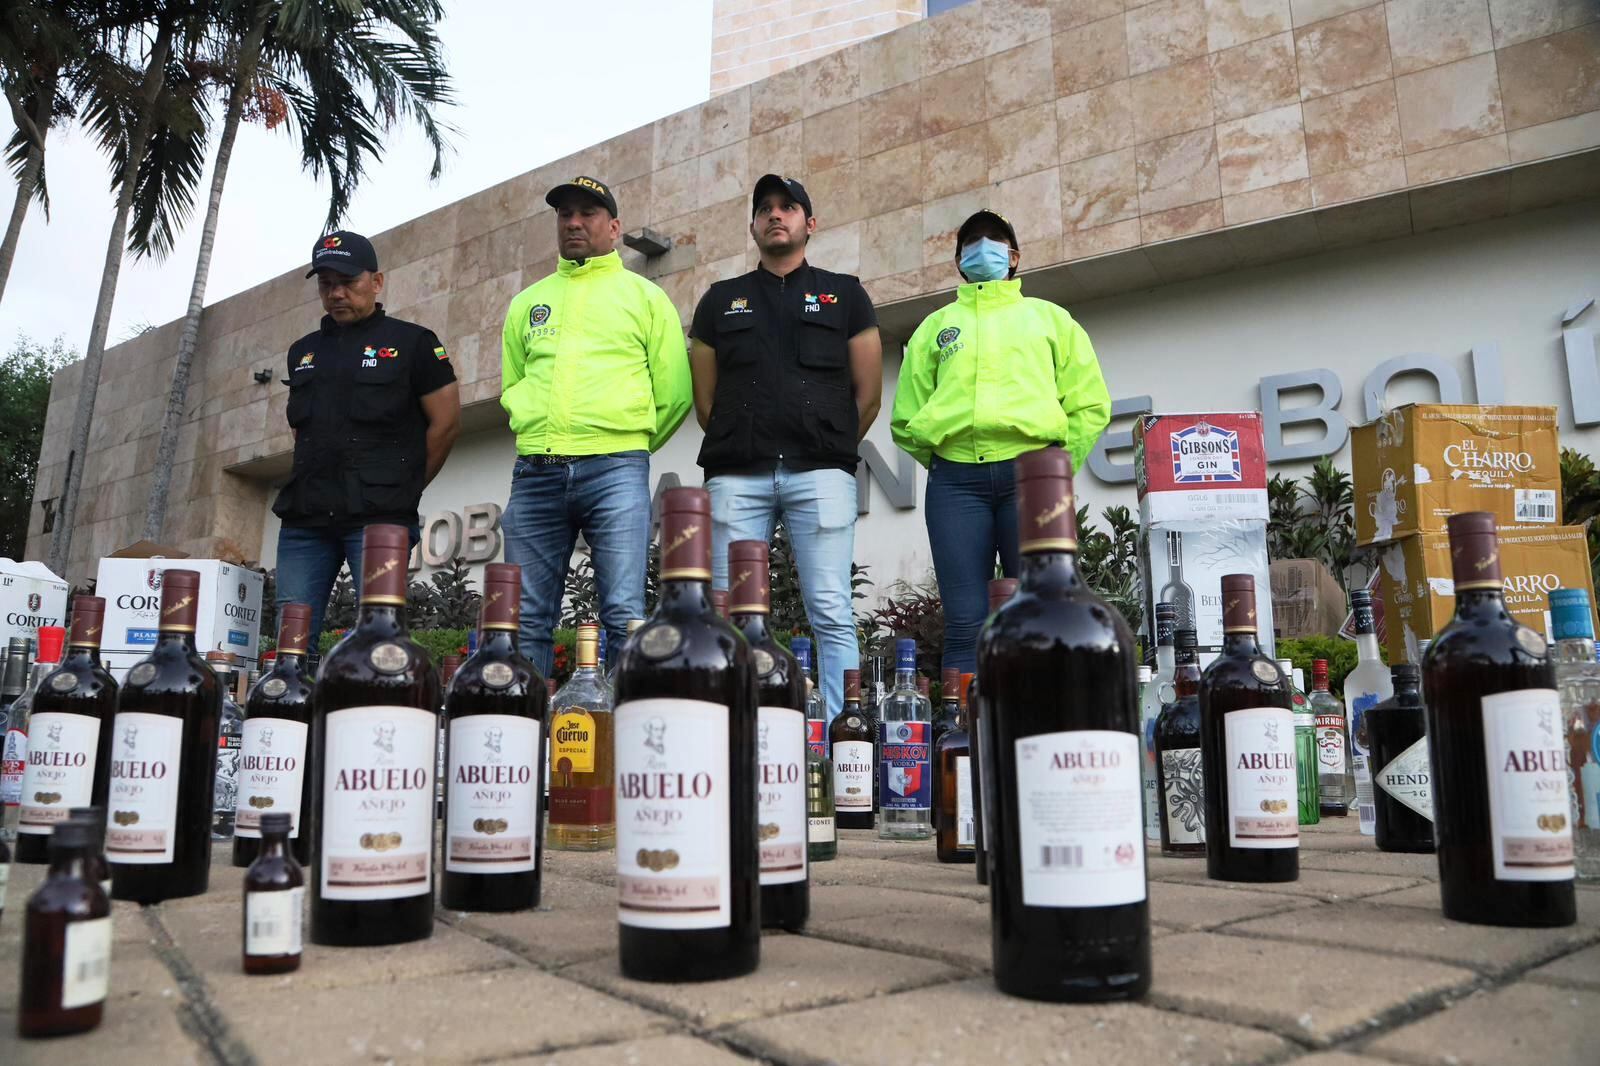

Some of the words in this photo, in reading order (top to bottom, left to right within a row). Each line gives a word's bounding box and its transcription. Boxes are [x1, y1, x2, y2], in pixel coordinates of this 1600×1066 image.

[570, 177, 605, 195] LICIA
[805, 303, 820, 313] FND
[362, 358, 377, 368] FND
[1462, 440, 1478, 450] EL
[1197, 461, 1218, 469] GIN
[1443, 444, 1532, 473] CHARRO
[1502, 573, 1560, 594] ARRO
[116, 594, 160, 610] COR
[1505, 594, 1543, 603] QUILA
[7, 612, 58, 628] CORTEZ
[224, 602, 257, 622] CORTEZ
[133, 631, 156, 639] BLAN
[1315, 716, 1344, 727] MIRNOFF
[556, 726, 589, 744] Cuervo
[27, 751, 87, 767] ABUELO
[241, 755, 296, 772] ABUELO
[1050, 751, 1120, 770] ABUELO
[1503, 749, 1569, 773] ABUEL
[110, 761, 166, 780] BUELO
[456, 765, 530, 784] ABUELO
[757, 763, 799, 785] UELO
[836, 763, 871, 773] ABUELO
[335, 768, 427, 791] ABUELO
[619, 772, 713, 800] ABUELO
[1386, 774, 1429, 786] HEND
[472, 790, 512, 803] AÑEJO
[358, 799, 406, 814] AÑEJO
[634, 807, 683, 825] AÑEJO
